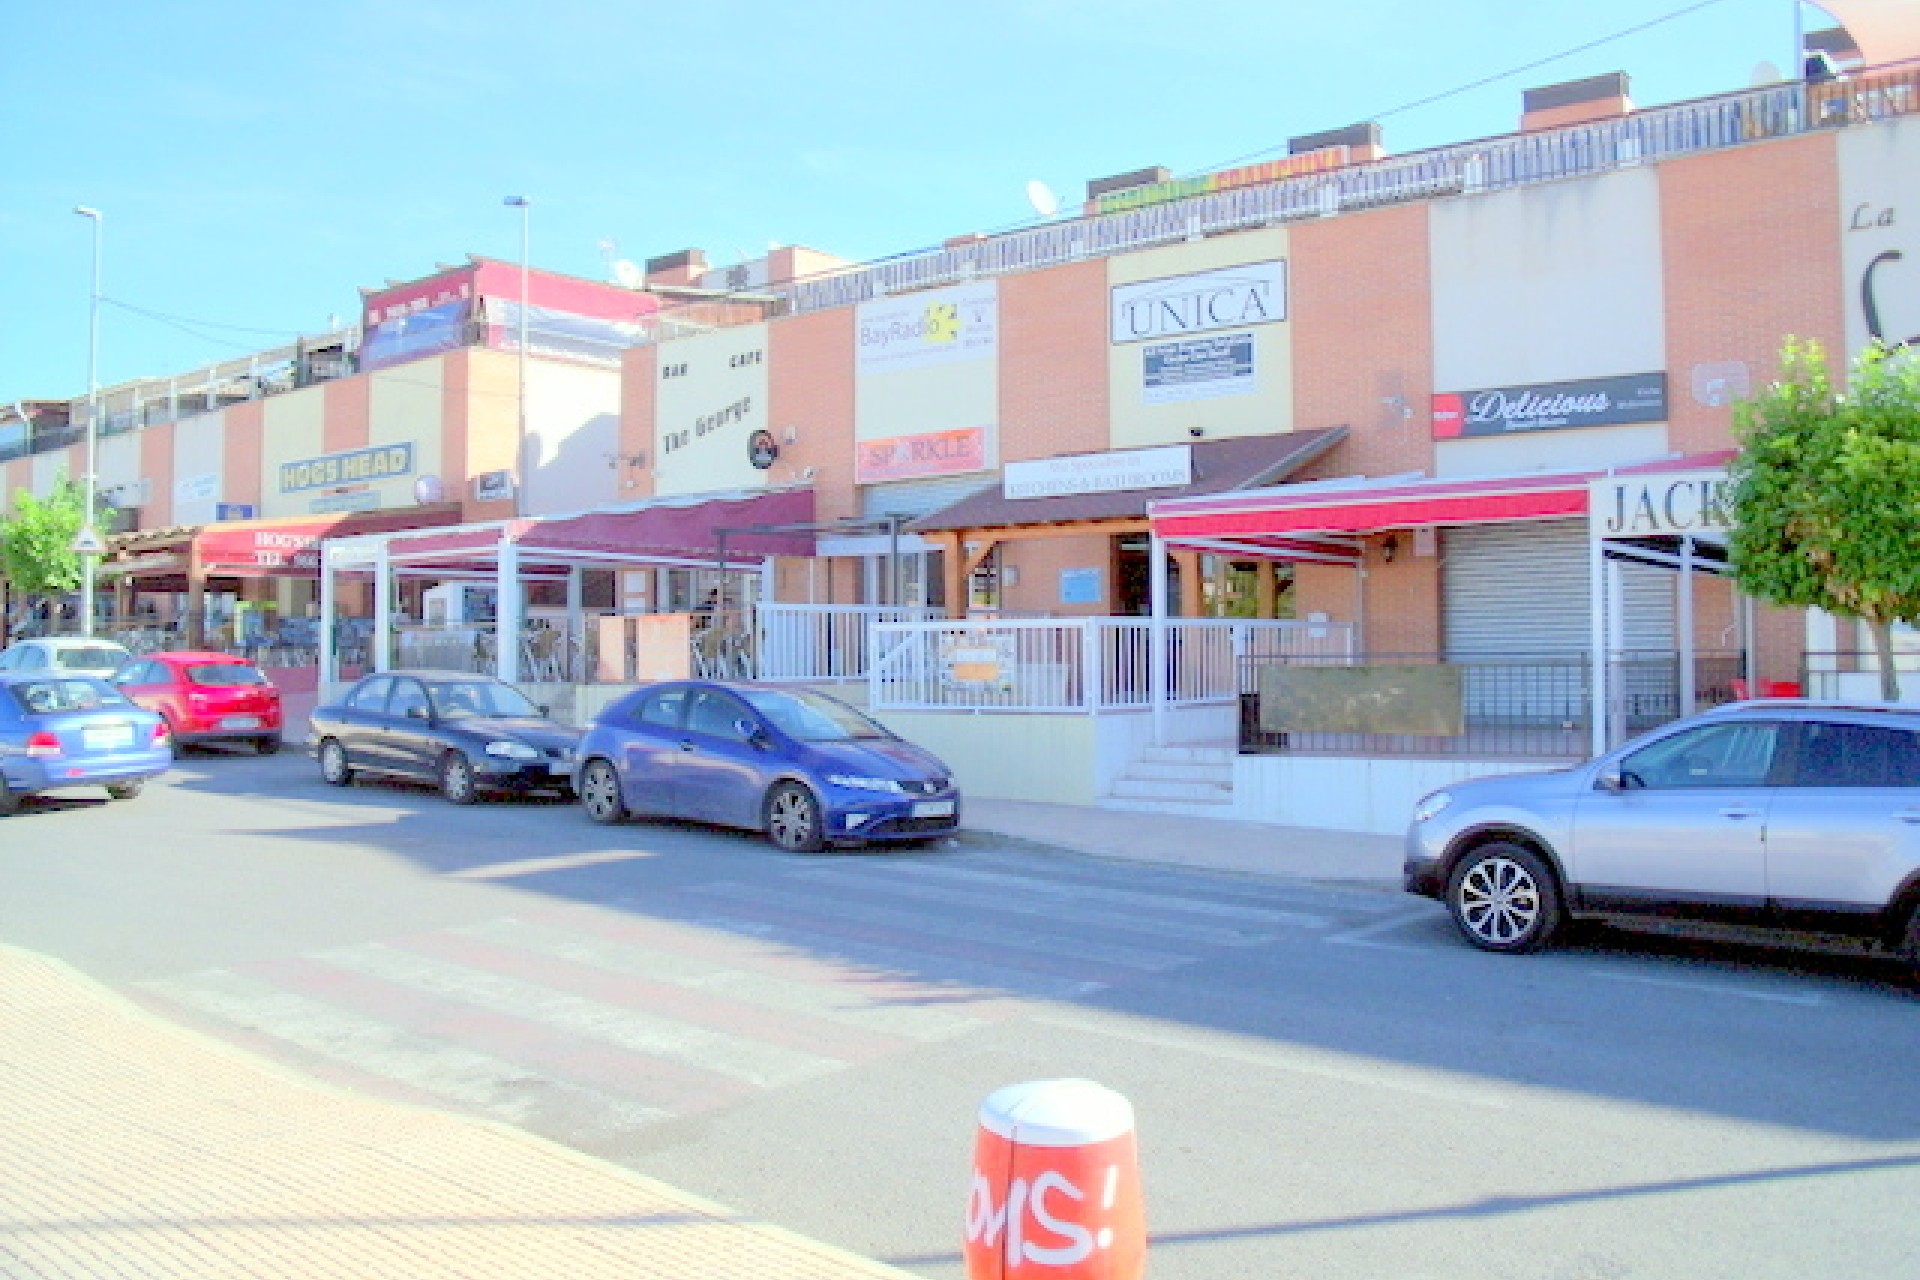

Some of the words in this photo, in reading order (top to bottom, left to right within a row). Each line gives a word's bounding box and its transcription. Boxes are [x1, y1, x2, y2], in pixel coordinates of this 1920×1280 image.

[1847, 202, 1896, 232] La
[1126, 287, 1268, 336] UNICA
[1464, 389, 1612, 425] Delicious
[283, 462, 337, 488] HOGS
[344, 447, 406, 480] HEAD
